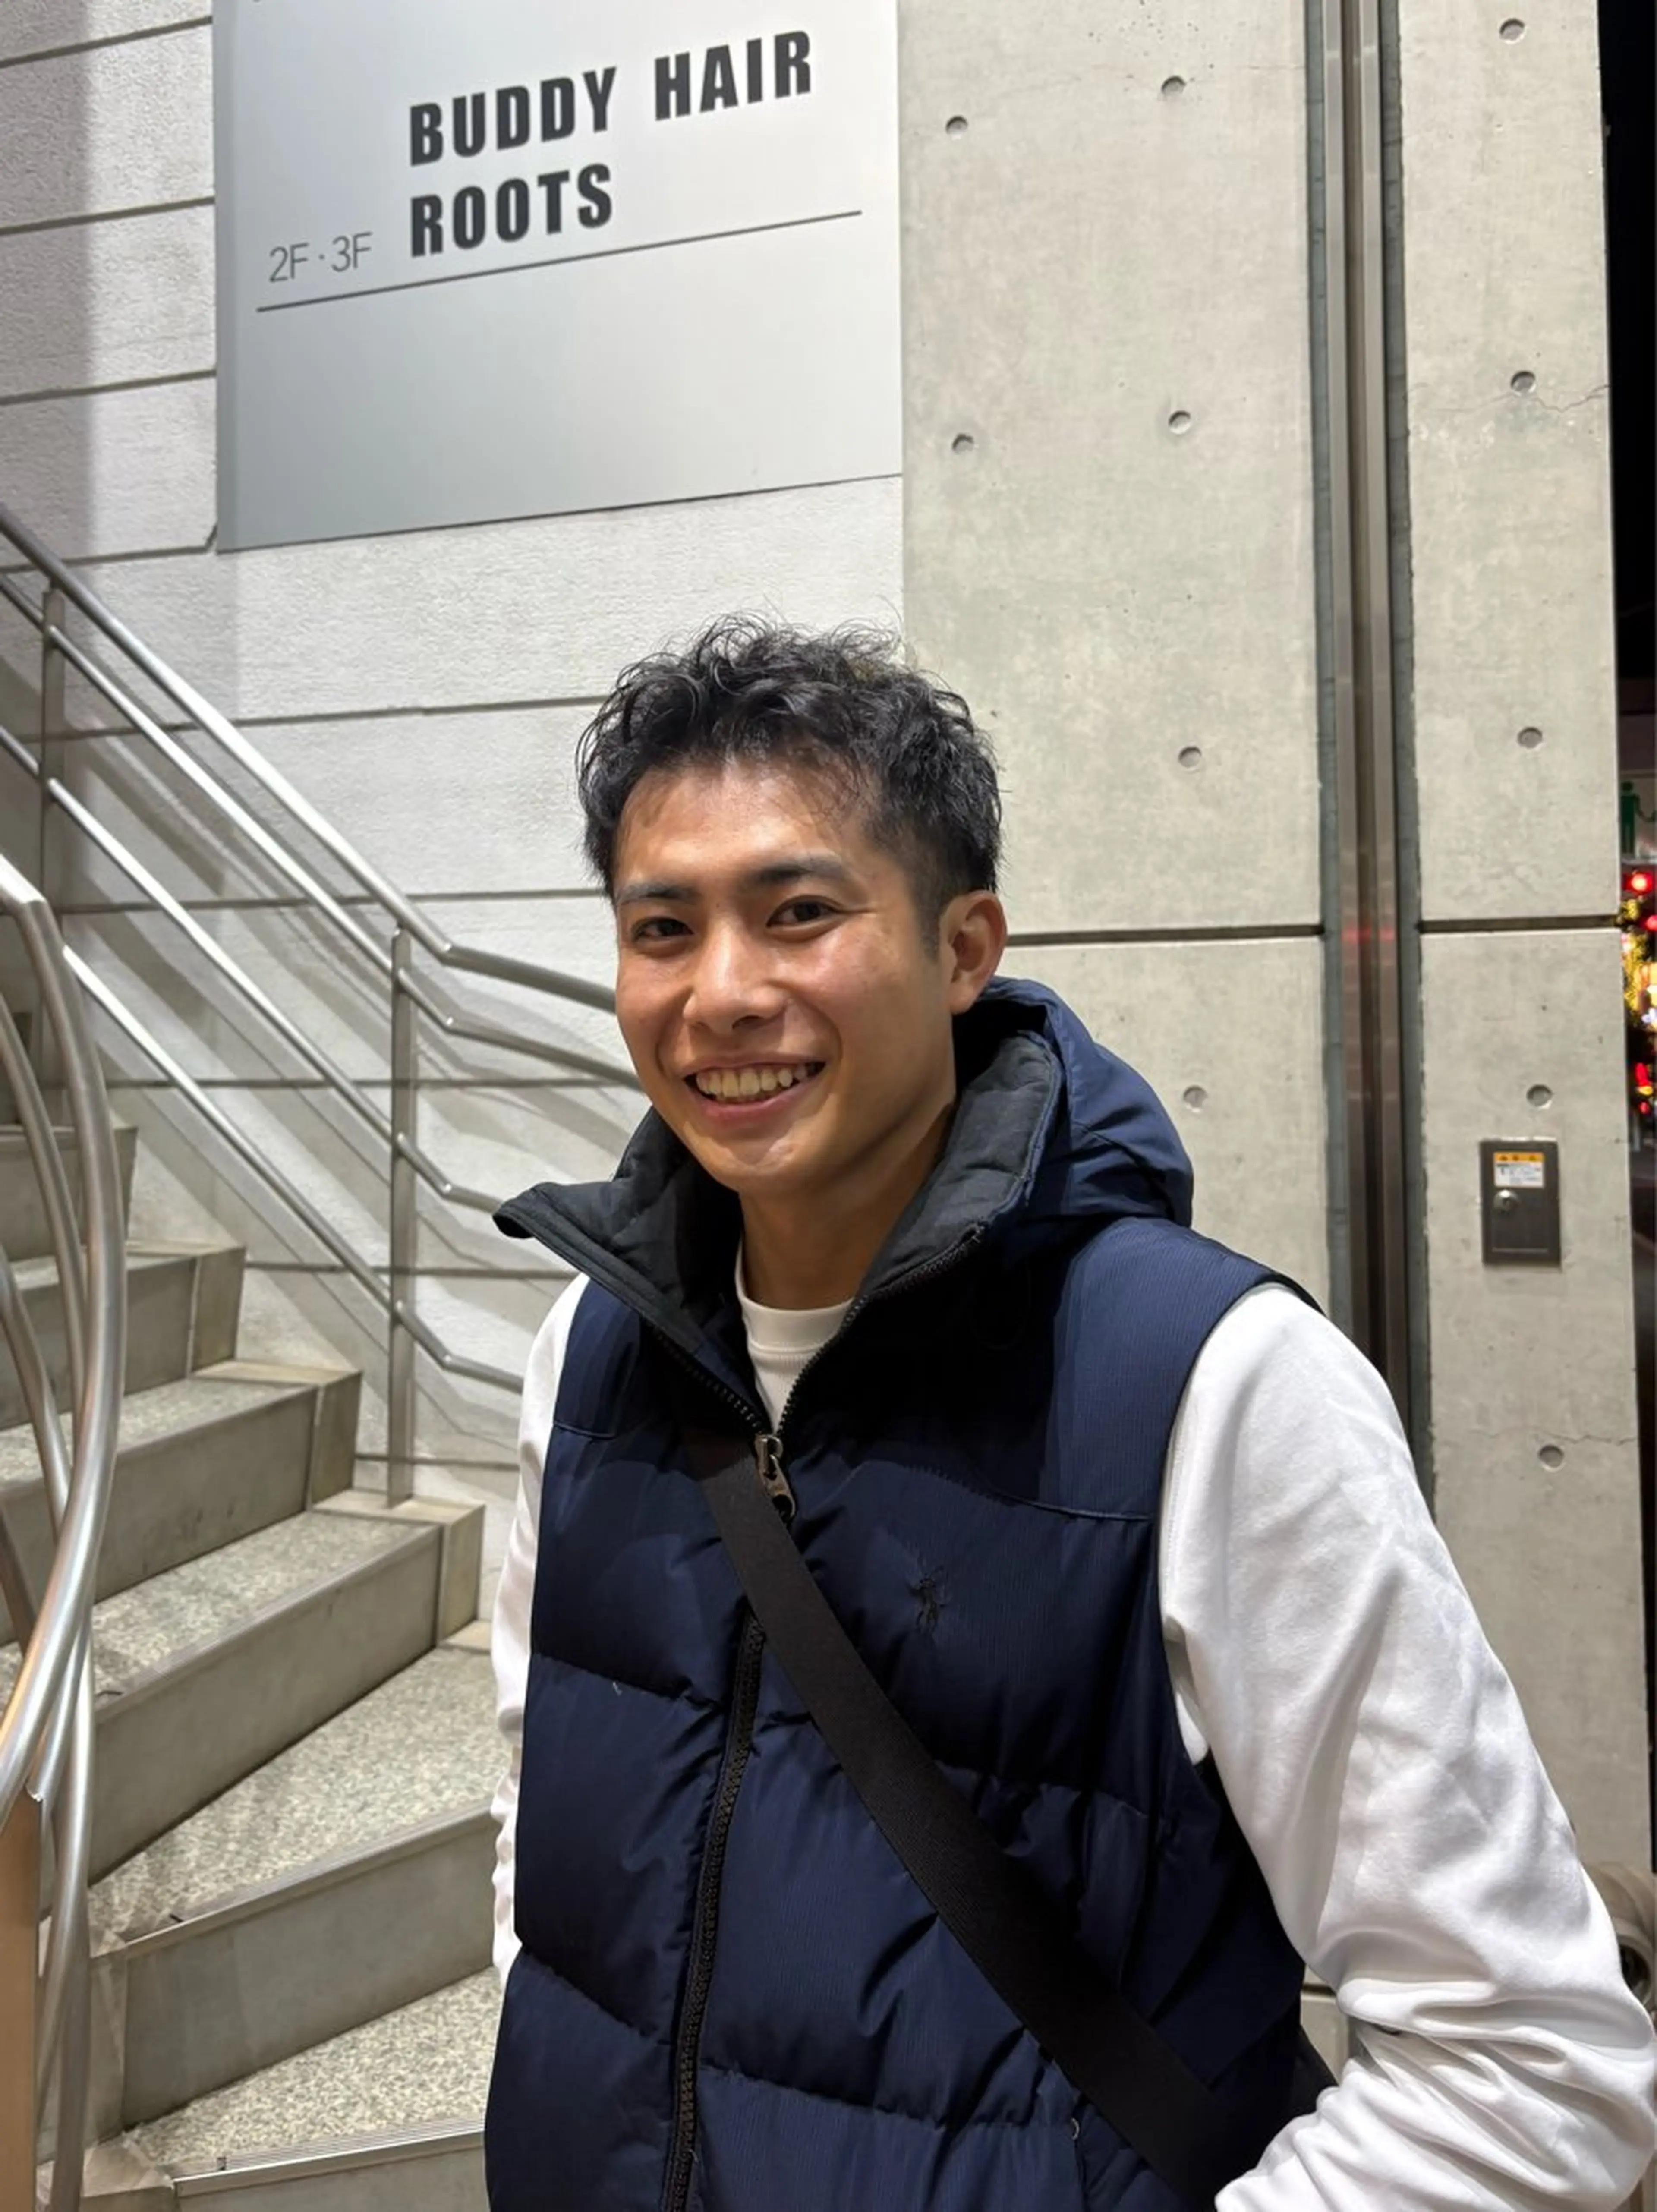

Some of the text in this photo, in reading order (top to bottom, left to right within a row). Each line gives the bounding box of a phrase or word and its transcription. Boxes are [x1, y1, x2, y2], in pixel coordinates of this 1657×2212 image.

[410, 31, 811, 167] BUDDY HAIR
[410, 164, 612, 258] ROOTS
